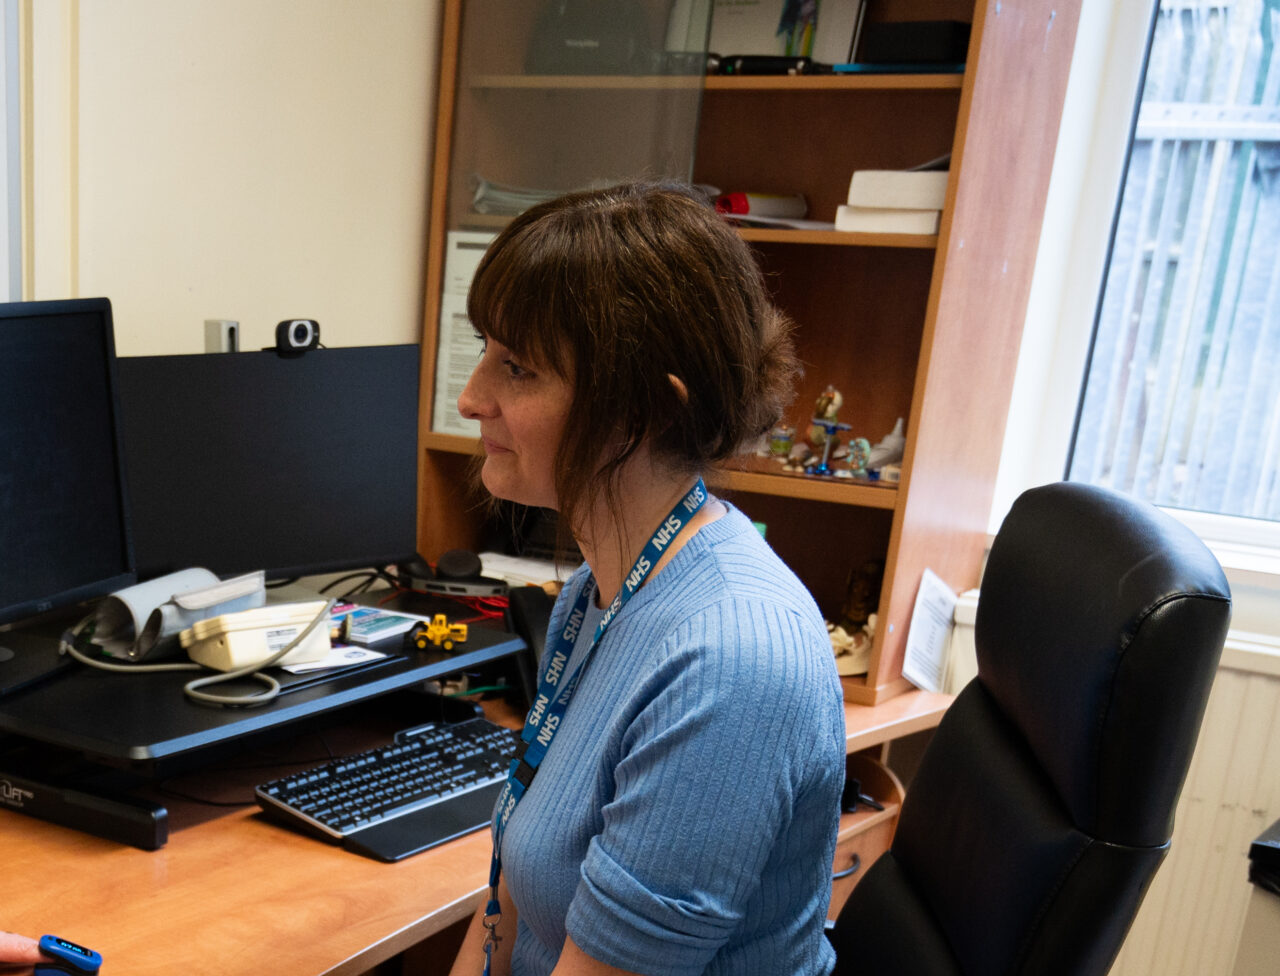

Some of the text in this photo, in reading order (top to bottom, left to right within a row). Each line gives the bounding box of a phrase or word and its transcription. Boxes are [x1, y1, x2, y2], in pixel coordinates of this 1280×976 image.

[682, 486, 705, 514] NHS
[651, 514, 682, 551] NHS
[625, 555, 651, 592] NHS
[563, 608, 585, 643] NHS
[599, 596, 622, 631] NHS
[545, 651, 567, 686] NHS
[529, 693, 550, 727] NHS
[536, 713, 560, 747] NHS
